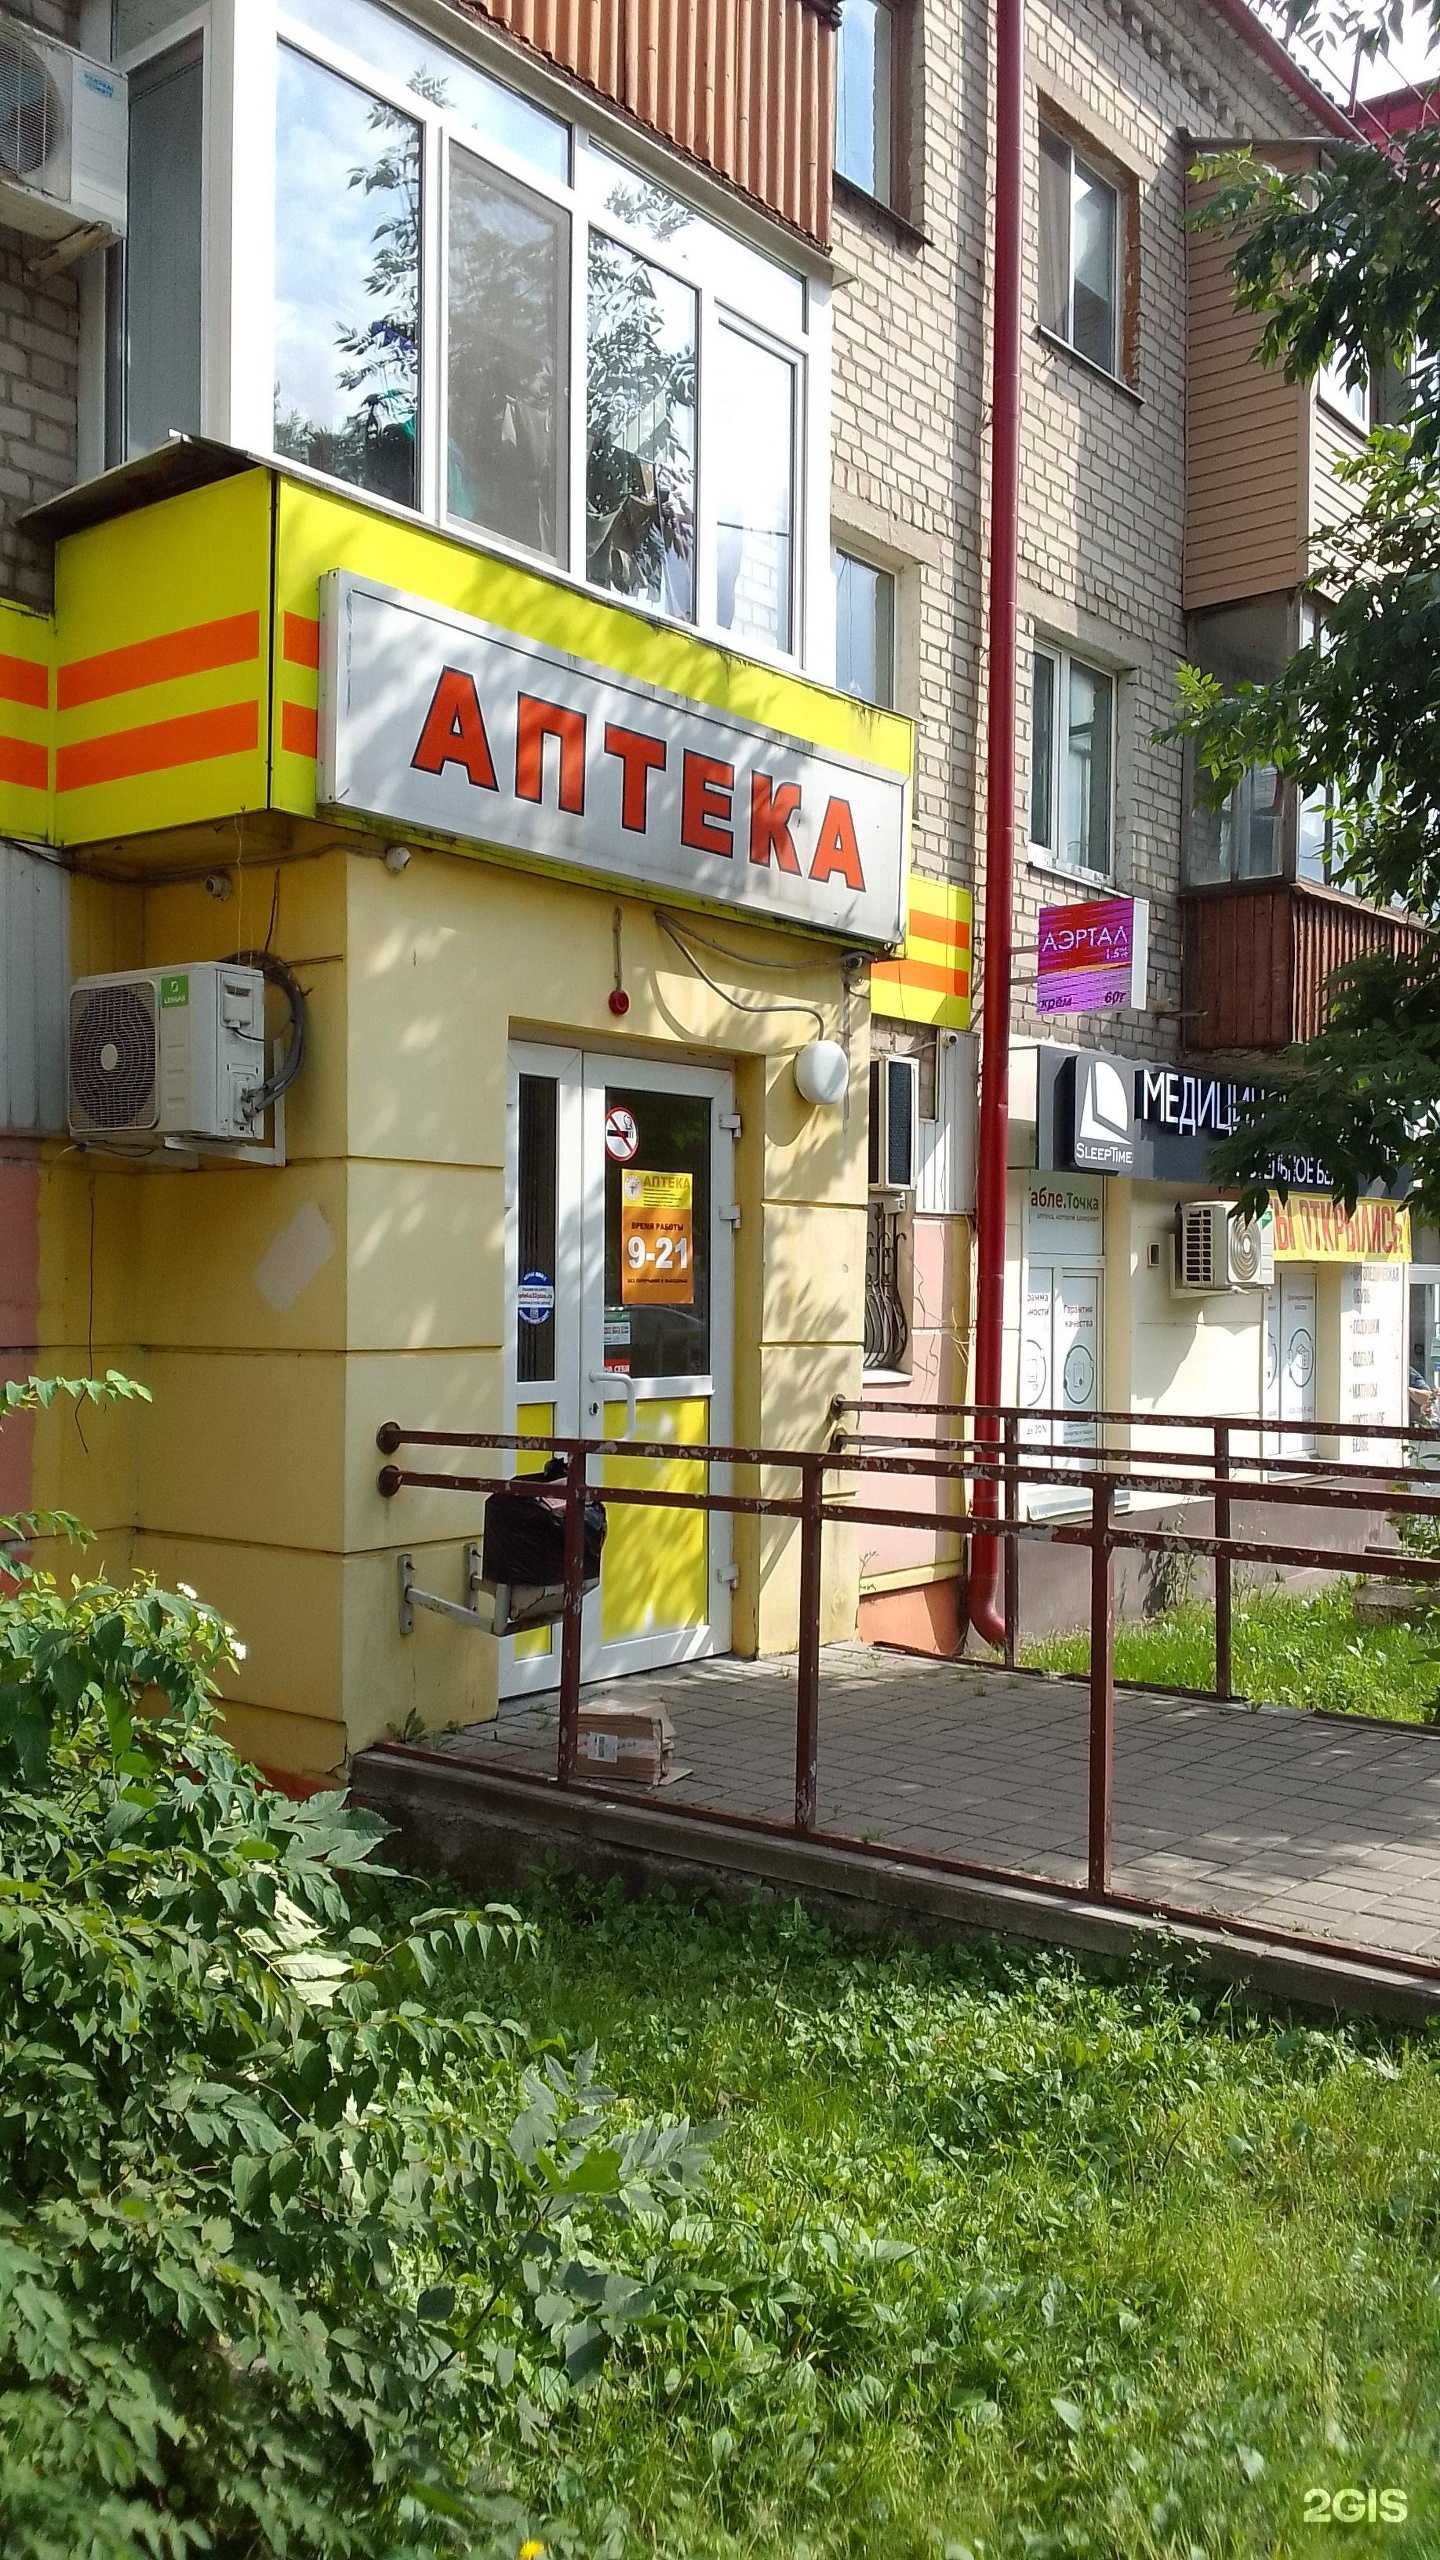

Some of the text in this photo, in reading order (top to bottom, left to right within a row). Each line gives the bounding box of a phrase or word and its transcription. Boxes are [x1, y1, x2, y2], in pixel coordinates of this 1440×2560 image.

[409, 664, 867, 893] АПТЕКА
[1041, 925, 1129, 952] АЭРТАЛ
[643, 1175, 691, 1189] АПТЕКА
[631, 1222, 684, 1232] ВРЕМЯ РАБОТЫ
[627, 1235, 689, 1270] 9-21
